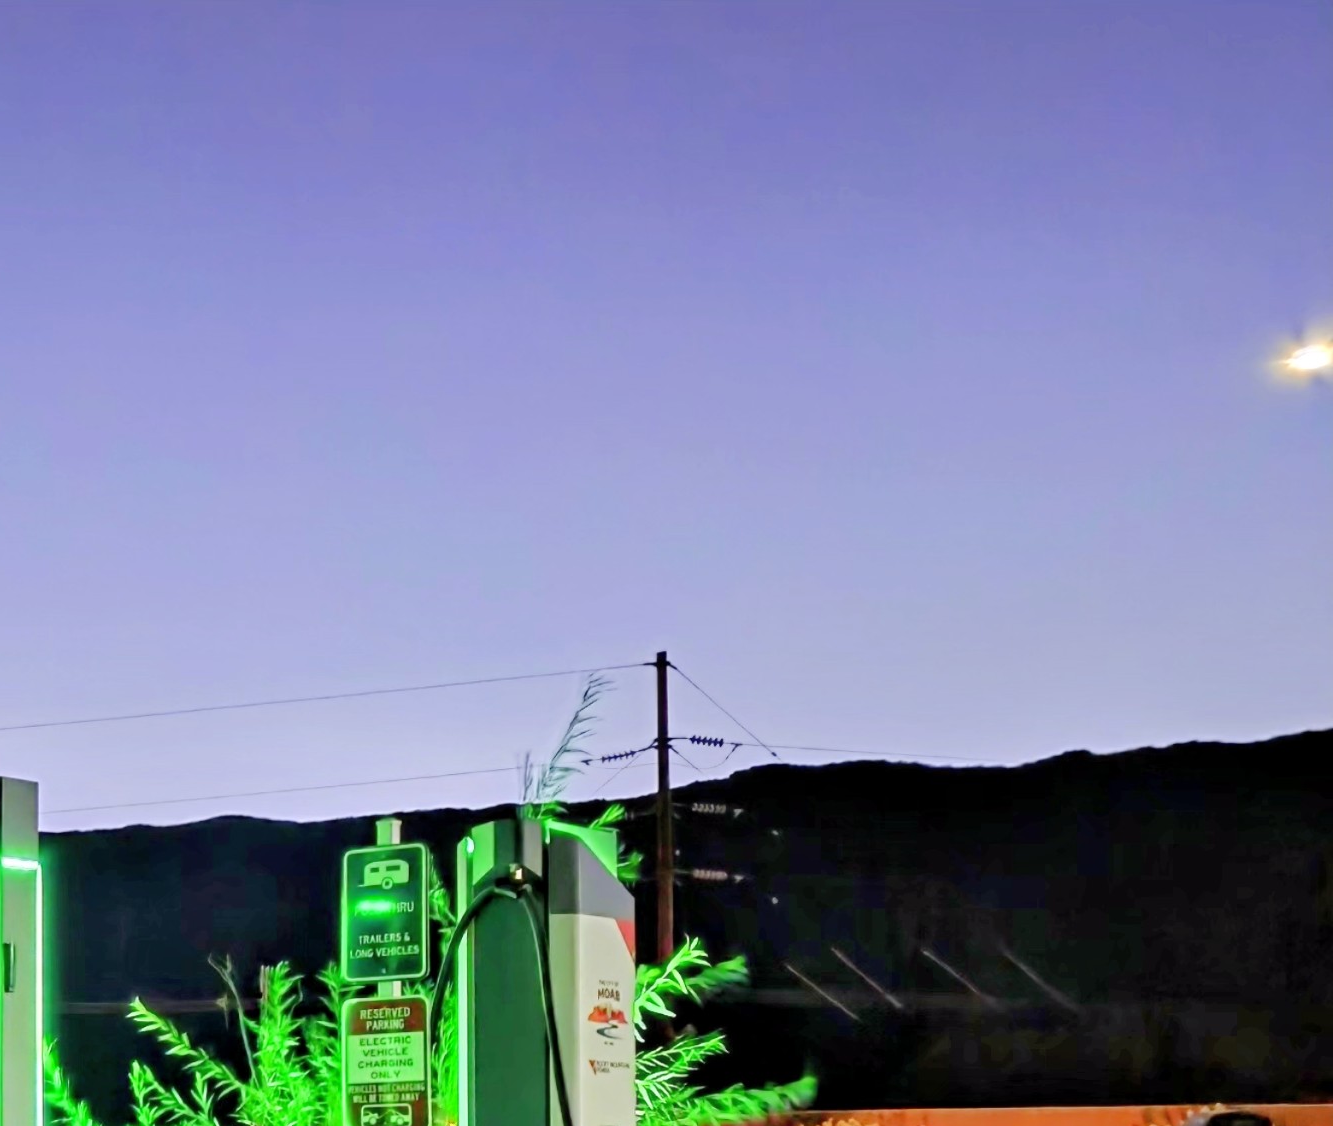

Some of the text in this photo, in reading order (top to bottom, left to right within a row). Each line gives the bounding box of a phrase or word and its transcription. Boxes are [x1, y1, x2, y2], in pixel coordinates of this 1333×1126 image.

[359, 932, 402, 946] TRAILERS
[349, 944, 420, 960] LONG VEHICLES
[597, 987, 620, 1002] MOAB
[359, 1006, 411, 1020] RESERVED
[365, 1018, 405, 1031] PARKING
[359, 1035, 412, 1047] ELECTRIC
[362, 1046, 409, 1057] VEHICLE
[357, 1058, 414, 1069] CHARGING
[370, 1070, 401, 1080] ONLY
